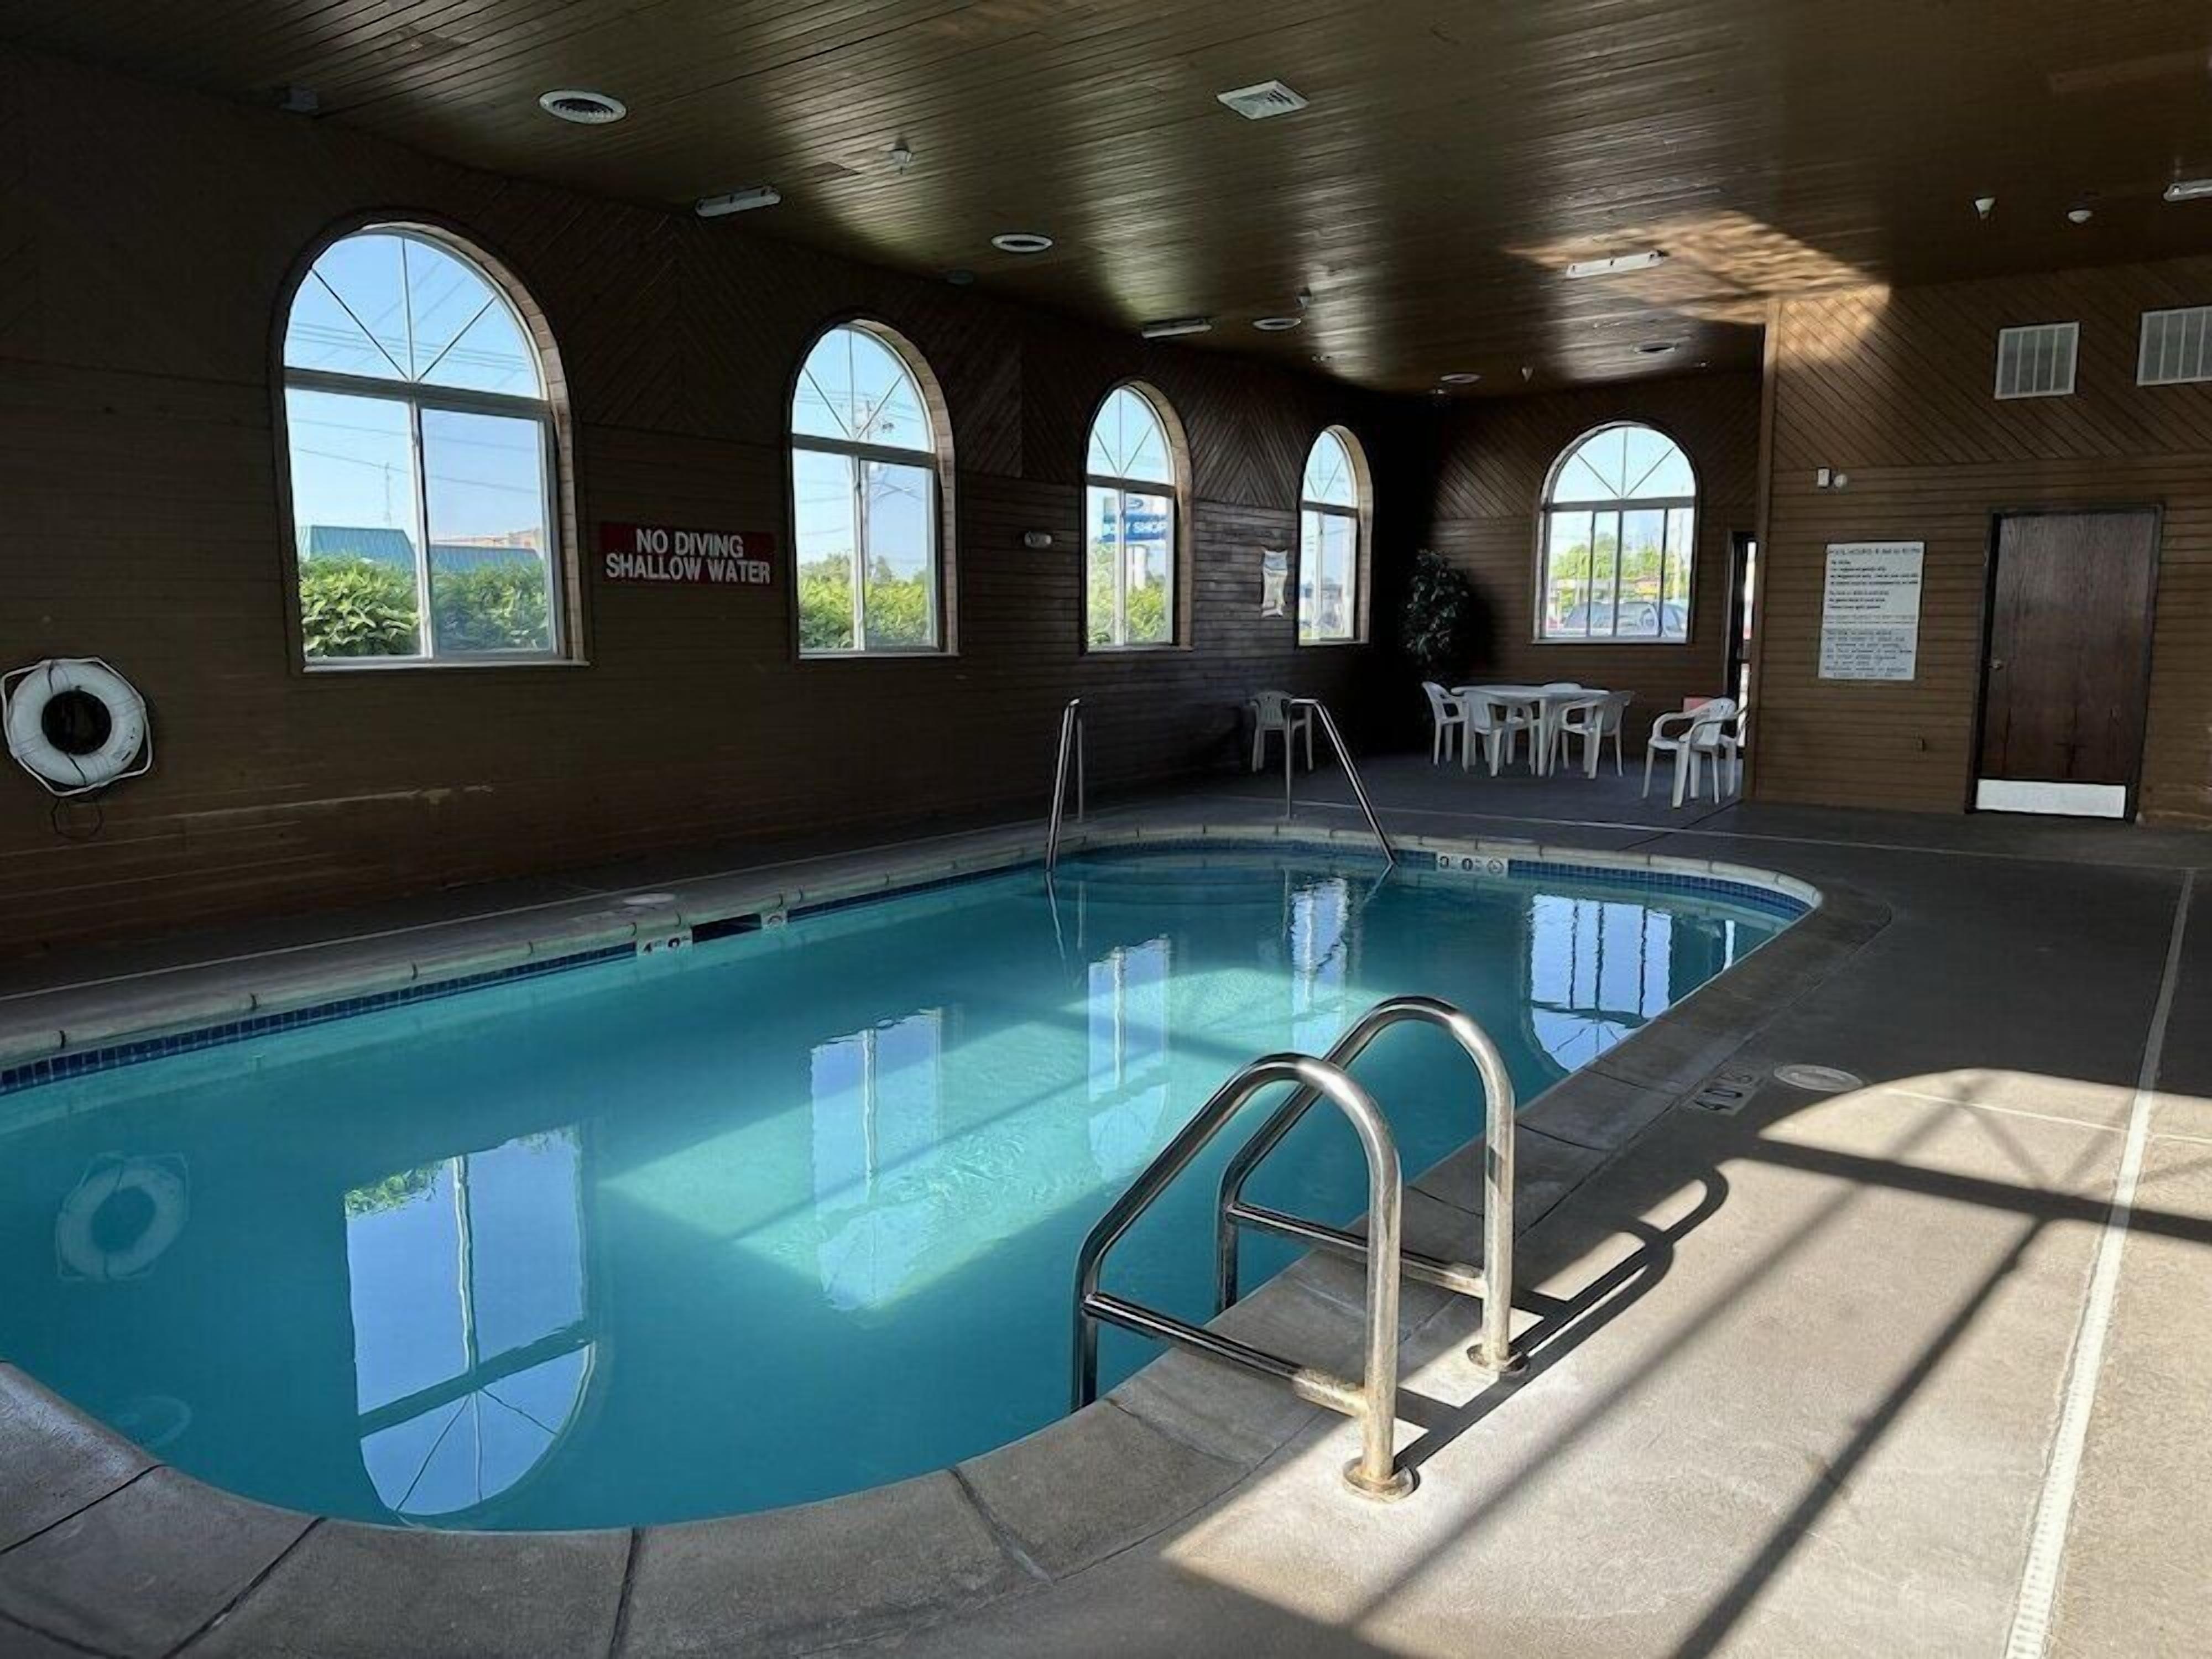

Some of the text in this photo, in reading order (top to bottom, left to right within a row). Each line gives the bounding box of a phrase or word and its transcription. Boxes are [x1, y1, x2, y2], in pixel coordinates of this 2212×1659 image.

[637, 529, 744, 558] NO DIVING
[606, 553, 770, 584] SHALLOW WATER
